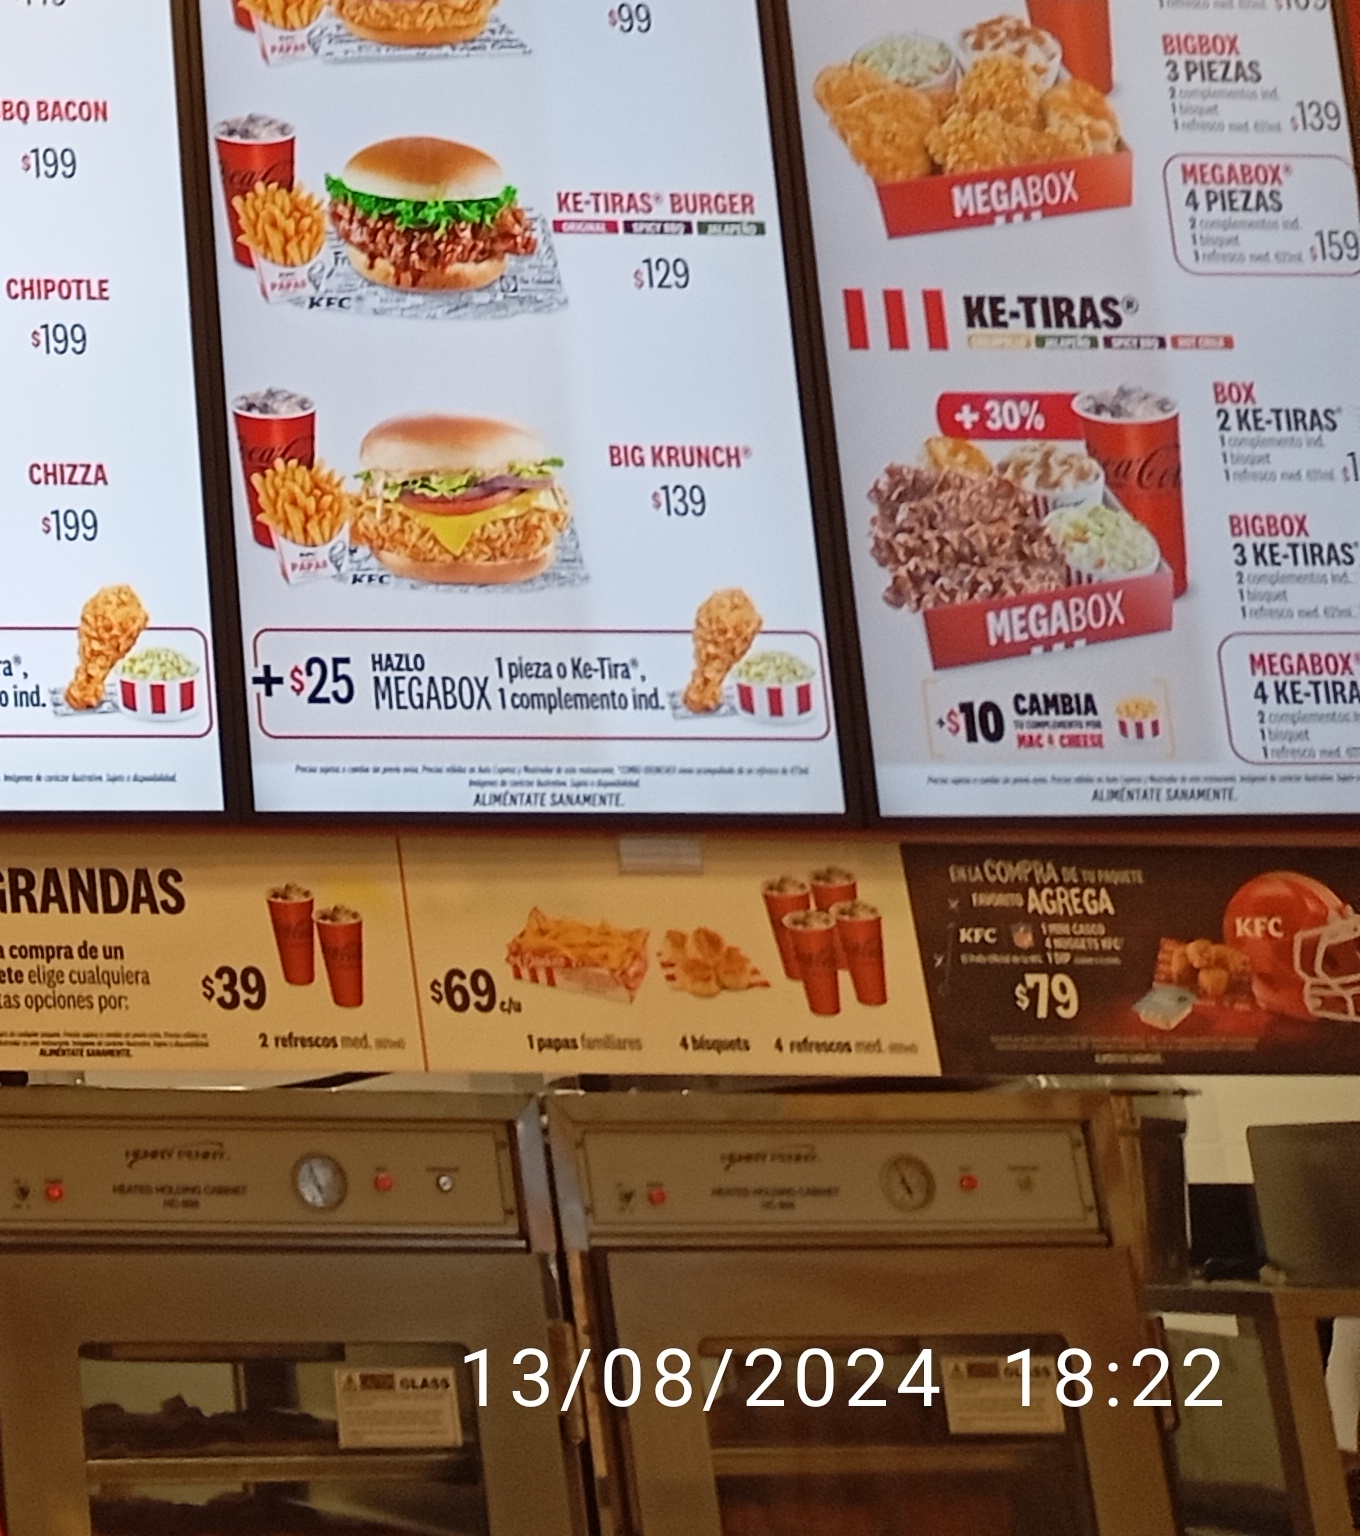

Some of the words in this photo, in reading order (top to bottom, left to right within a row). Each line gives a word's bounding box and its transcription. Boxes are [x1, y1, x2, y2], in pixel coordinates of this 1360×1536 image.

[607, 4, 651, 32] $99
[1163, 34, 1240, 56] BIGBOX
[1166, 61, 1180, 82] 3
[1185, 61, 1262, 83] PIEZAS
[36, 101, 109, 123] BACON
[1291, 100, 1342, 132] $139
[21, 149, 77, 178] $199
[669, 191, 755, 215] BURGER
[952, 170, 1079, 218] MEGABOX
[633, 258, 690, 290] $129
[6, 278, 110, 301] CHIPOTLE
[31, 323, 87, 355] $199
[1213, 382, 1256, 404] BOX
[985, 400, 1045, 431] 30%
[609, 445, 645, 467] BIG
[29, 464, 109, 486] CHIZZA
[651, 485, 707, 516] $139
[42, 509, 98, 541] $199
[371, 654, 424, 672] HAZLO
[290, 656, 355, 704] $25
[373, 675, 492, 710] MEGABOX
[1013, 693, 1098, 716] CAMBIA
[1027, 888, 1115, 916] AGREGA
[959, 928, 997, 944] KFC
[1236, 916, 1283, 938] KFC
[8, 941, 73, 964] compra
[78, 940, 99, 960] de
[102, 944, 124, 960] un
[202, 967, 267, 1010] $39
[1015, 973, 1079, 1019] $79
